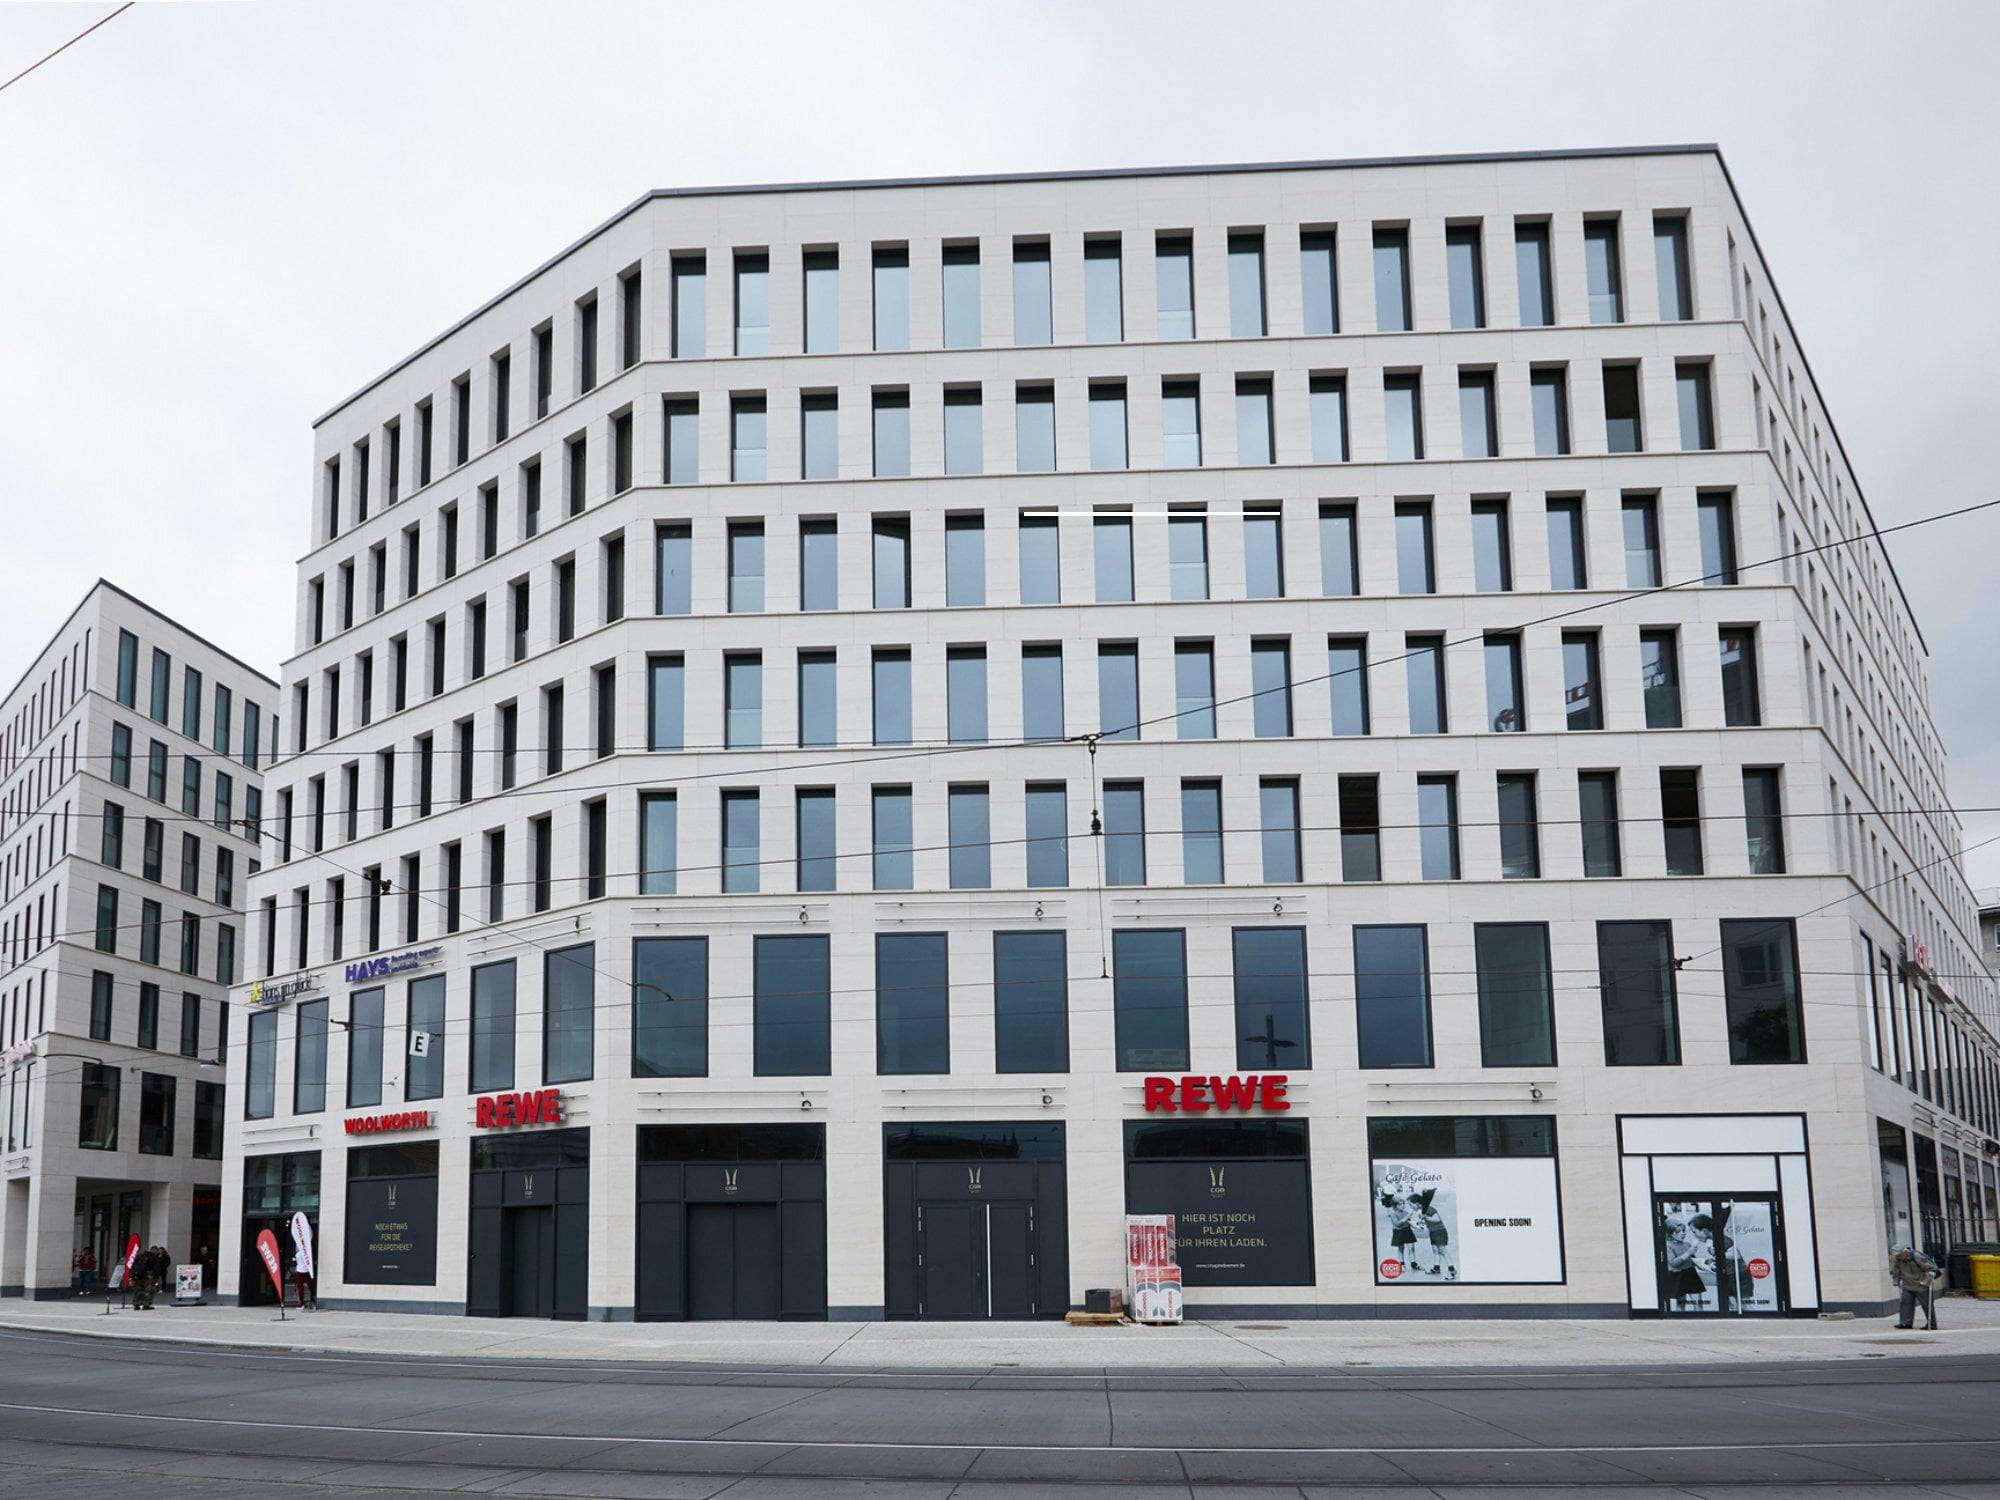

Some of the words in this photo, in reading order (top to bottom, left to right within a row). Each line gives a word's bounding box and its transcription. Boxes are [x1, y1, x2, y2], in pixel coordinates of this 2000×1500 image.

[345, 957, 389, 982] HAYS
[415, 1035, 424, 1052] E
[1144, 1075, 1291, 1112] REWE
[476, 1088, 561, 1128] REWE
[344, 1110, 429, 1135] WOOLWORTH
[1410, 1171, 1442, 1184] Gelato
[1182, 1213, 1206, 1222] HIER
[1209, 1213, 1224, 1222] IST
[1227, 1213, 1256, 1222] NOCH
[1474, 1218, 1507, 1227] OPENING
[1508, 1218, 1531, 1227] SOON!
[1203, 1225, 1236, 1235] PLATZ
[1195, 1238, 1227, 1247] IHREN
[1230, 1238, 1268, 1247] LADEN.
